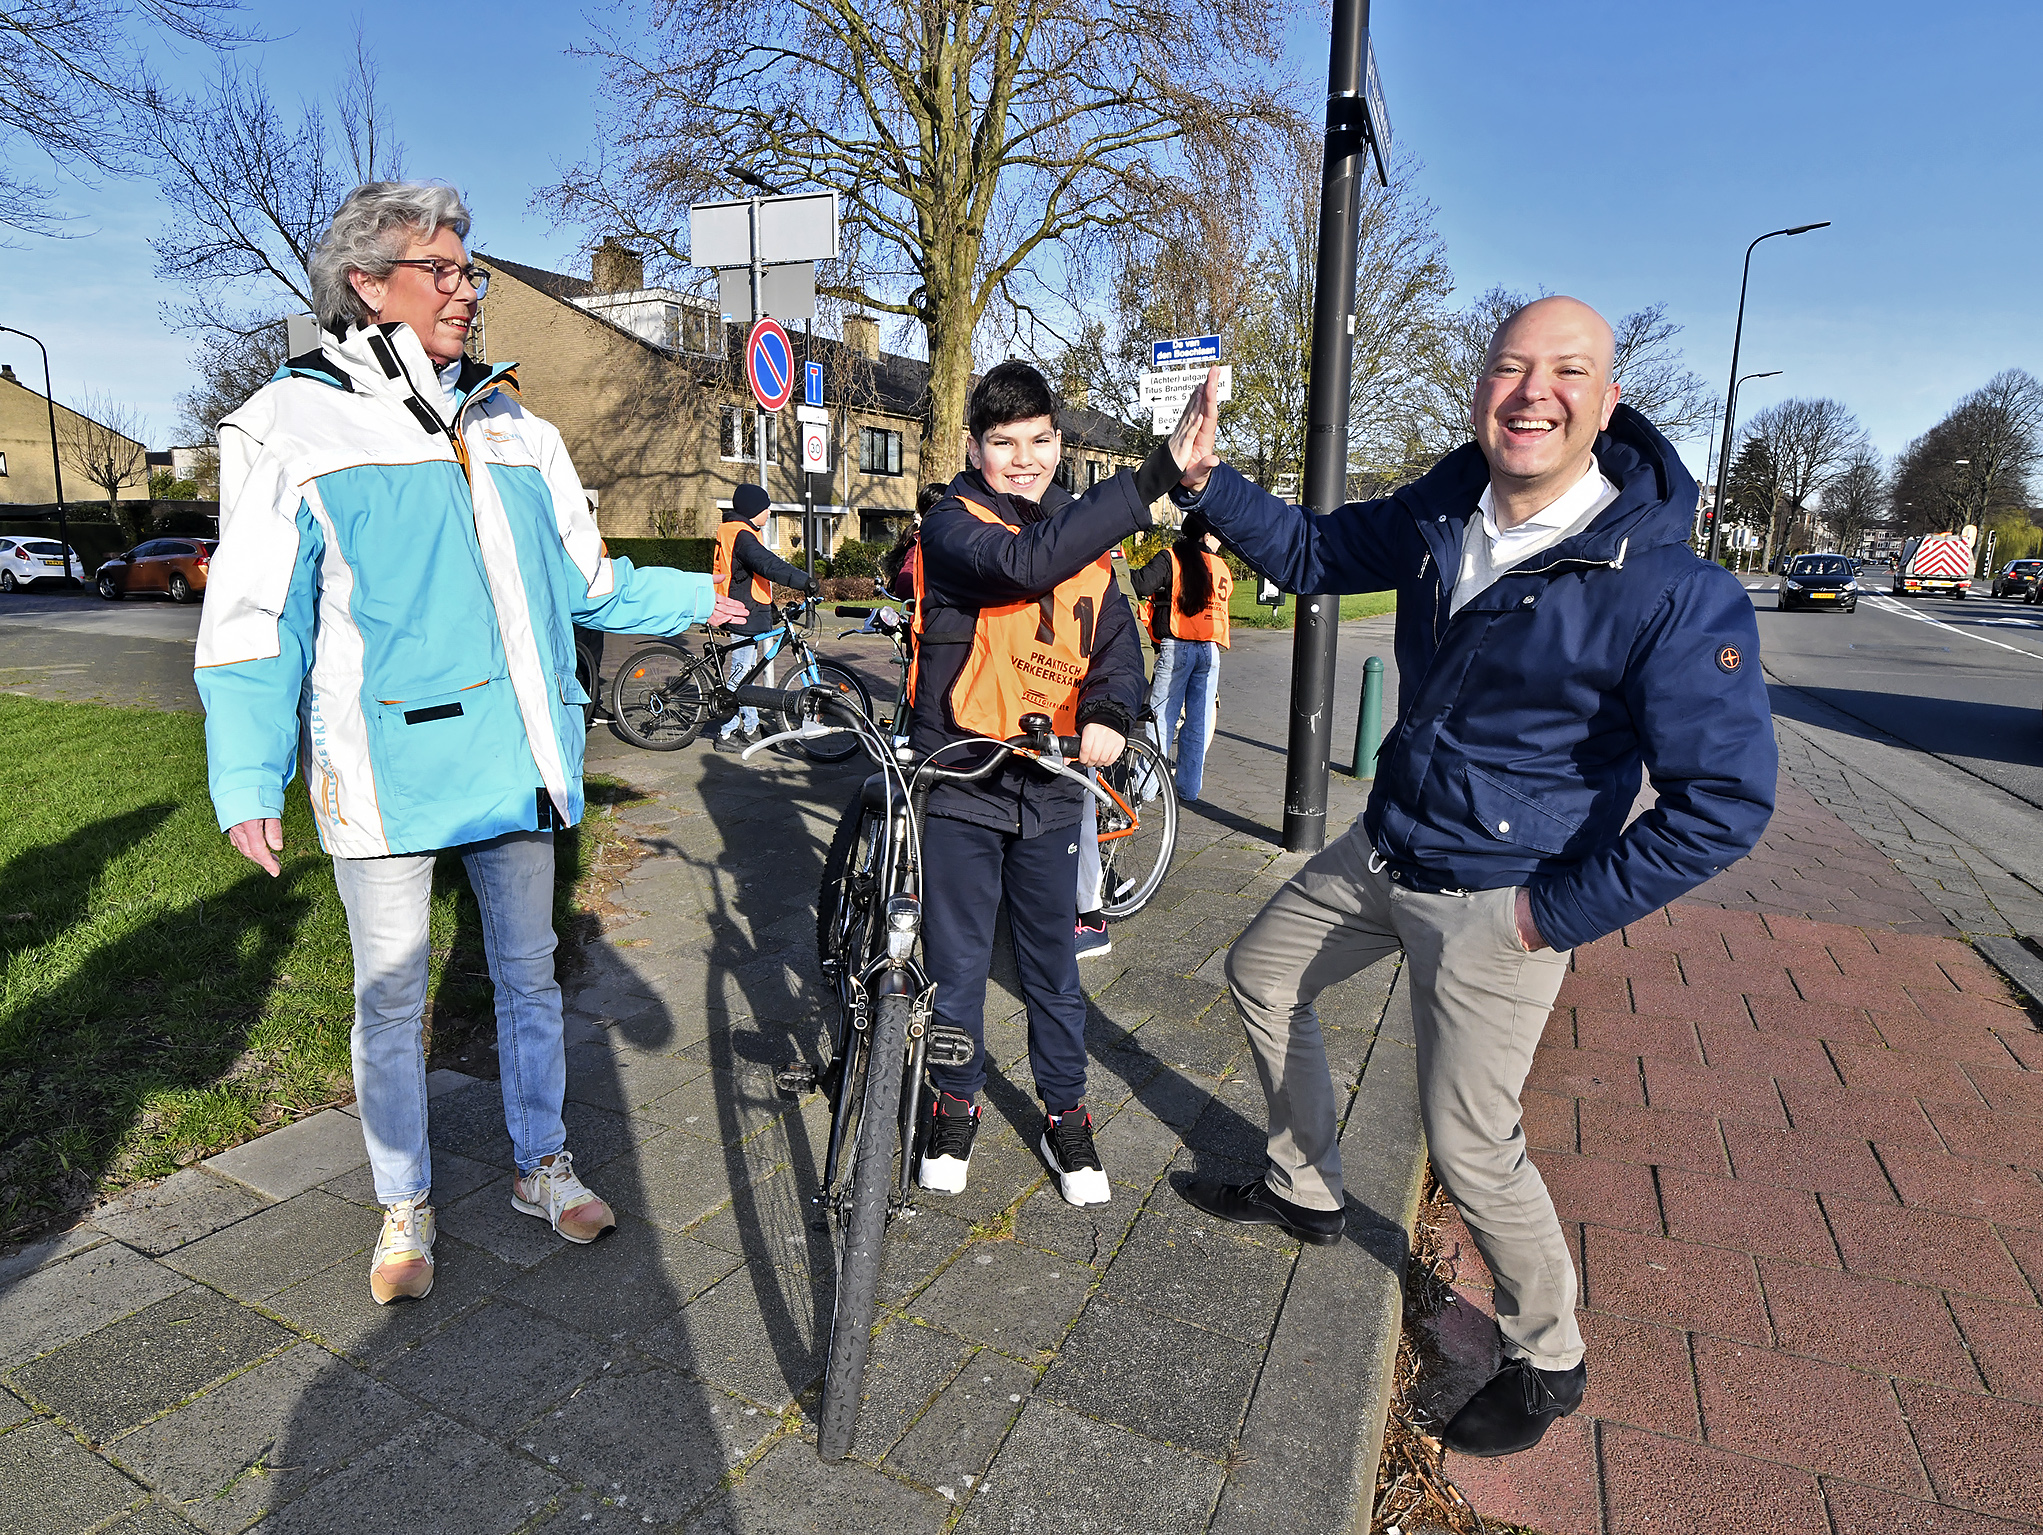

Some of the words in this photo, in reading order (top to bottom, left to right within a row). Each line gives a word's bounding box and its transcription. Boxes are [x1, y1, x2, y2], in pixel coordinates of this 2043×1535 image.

[1150, 375, 1180, 385] (Achter)
[1182, 374, 1208, 382] uitgan
[810, 443, 821, 454] 30
[1030, 651, 1082, 676] PRAKTISCH
